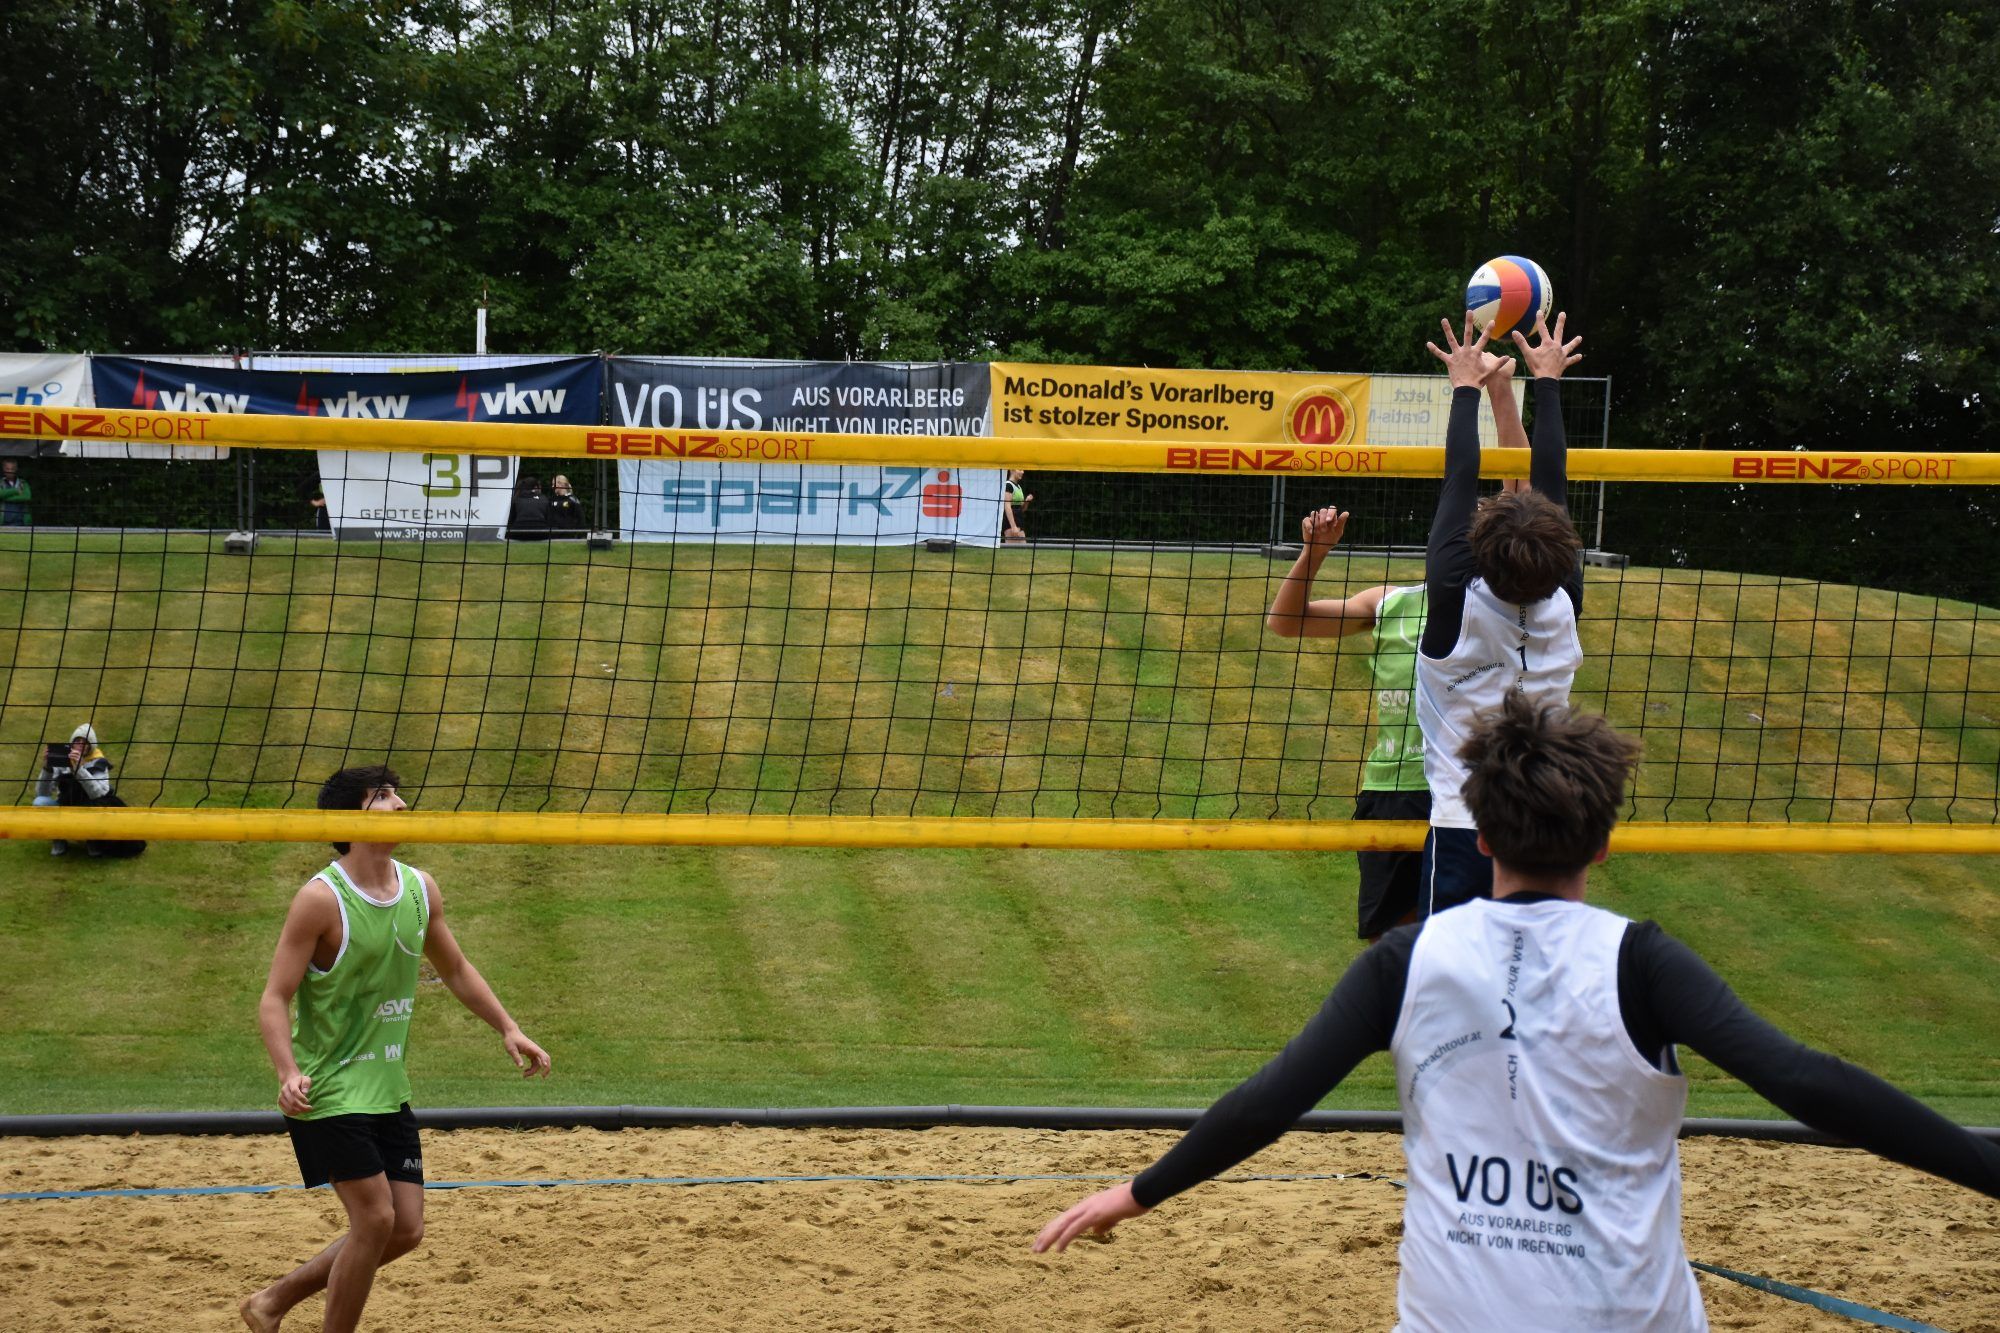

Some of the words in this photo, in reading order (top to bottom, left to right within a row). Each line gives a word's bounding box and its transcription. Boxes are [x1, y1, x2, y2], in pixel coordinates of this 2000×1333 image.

[159, 383, 250, 413] vkw
[322, 391, 410, 418] vkw
[481, 383, 566, 415] vkw
[615, 383, 682, 429] VO
[791, 387, 830, 406] AUS
[836, 387, 964, 408] VORARLBERG
[1004, 376, 1143, 401] McDonald’s
[1150, 382, 1274, 411] Vorarlberg
[117, 416, 211, 440] SPORT
[772, 417, 830, 433] NICHT
[836, 417, 875, 434] VON
[882, 417, 982, 436] IRGENDWO
[1003, 403, 1033, 424] ist
[1039, 404, 1119, 428] stolzer
[1125, 409, 1229, 434] Sponsor.
[730, 437, 815, 460] SPORT
[1305, 450, 1387, 473] SPORT
[422, 453, 509, 497] 3P
[1873, 459, 1957, 480] SPORT
[360, 508, 480, 520] GEOTECHNIK
[374, 528, 464, 540] www.3Pgeo.com
[1516, 645, 1527, 671] 1
[1512, 930, 1524, 963] WEST
[1507, 966, 1520, 998] TOUR
[1500, 998, 1517, 1040] 2
[1508, 1054, 1518, 1100] BEACH
[1446, 1153, 1511, 1206] VO
[1459, 1212, 1485, 1227] AUS
[1488, 1215, 1572, 1237] VORARLBERG
[1446, 1230, 1481, 1247] NICHT
[1487, 1233, 1513, 1250] VON
[1517, 1237, 1585, 1259] IRGENDWO
